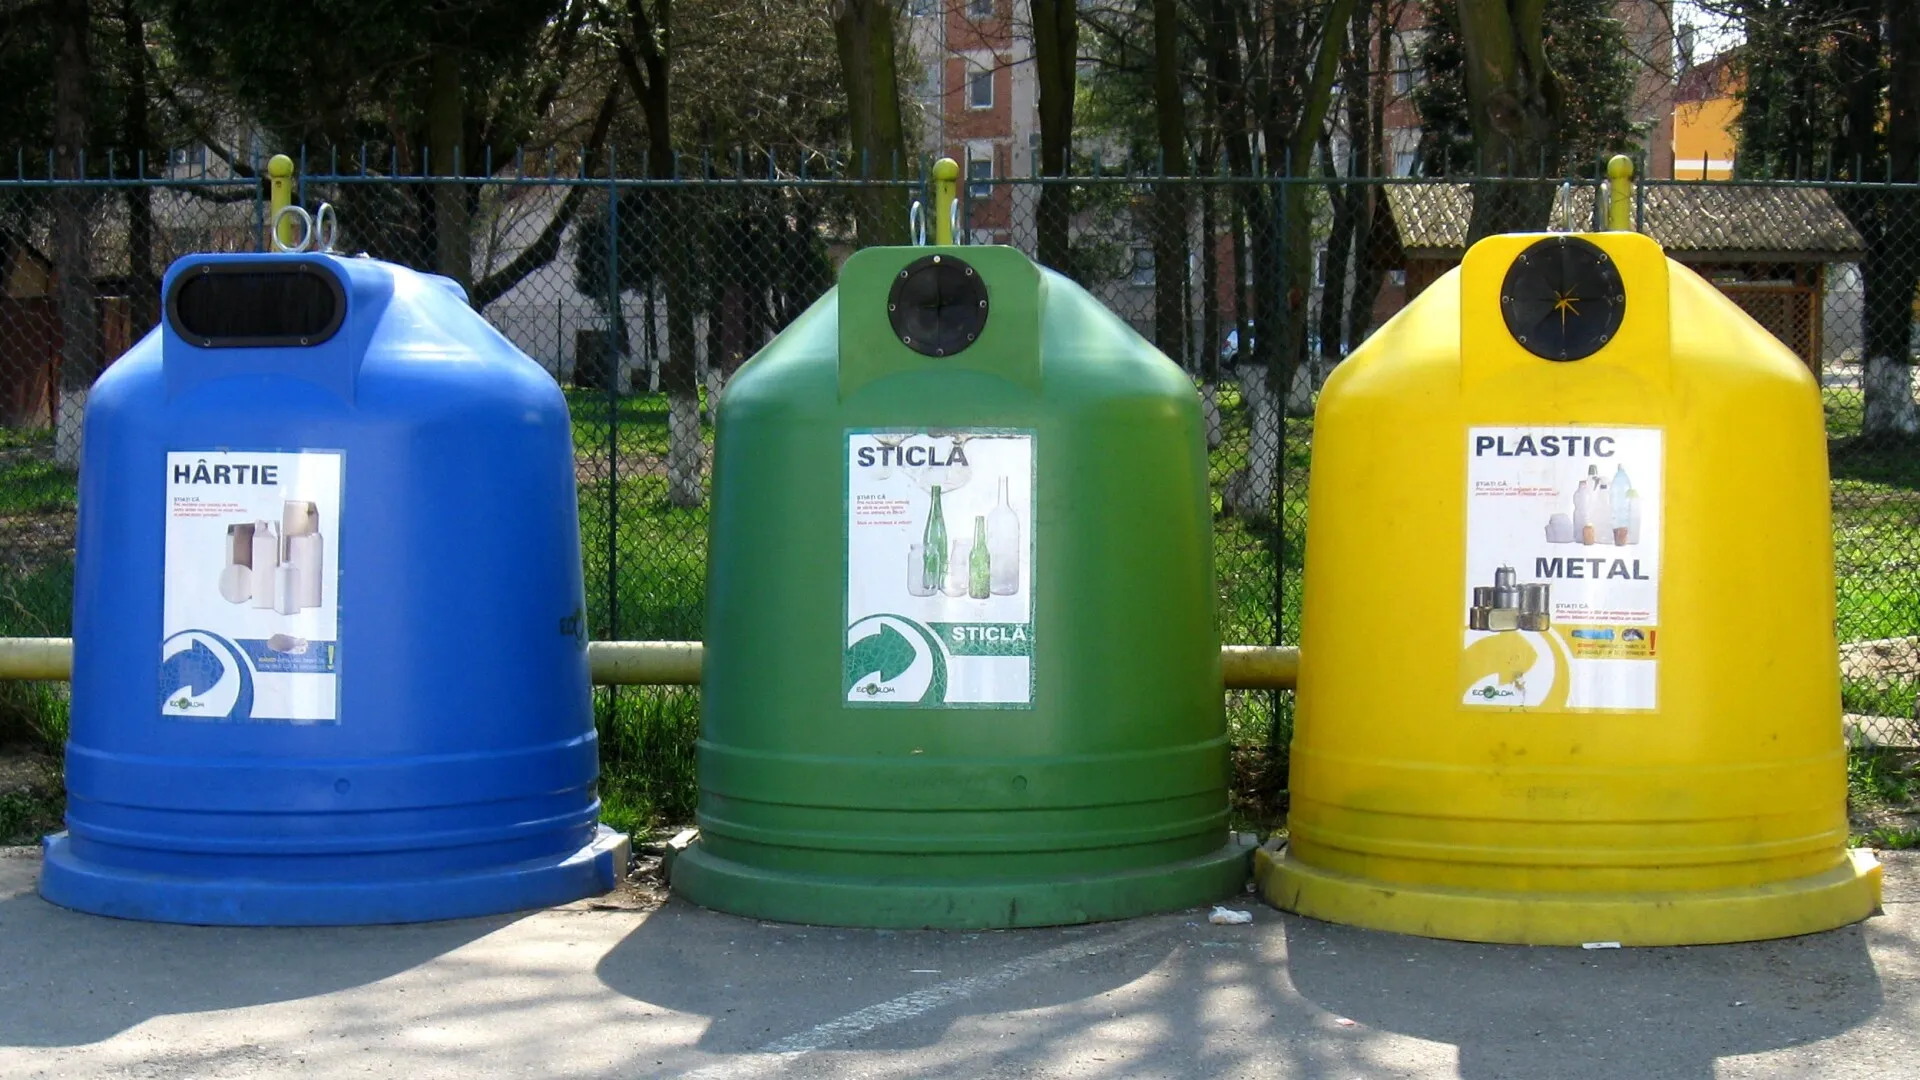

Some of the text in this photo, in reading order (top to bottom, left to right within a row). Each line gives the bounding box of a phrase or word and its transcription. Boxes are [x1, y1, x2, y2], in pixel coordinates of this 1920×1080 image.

[1476, 435, 1616, 457] PLASTIC
[174, 459, 278, 485] HÂRTIE
[1535, 557, 1650, 581] METAL
[951, 624, 1027, 642] STICLĂ
